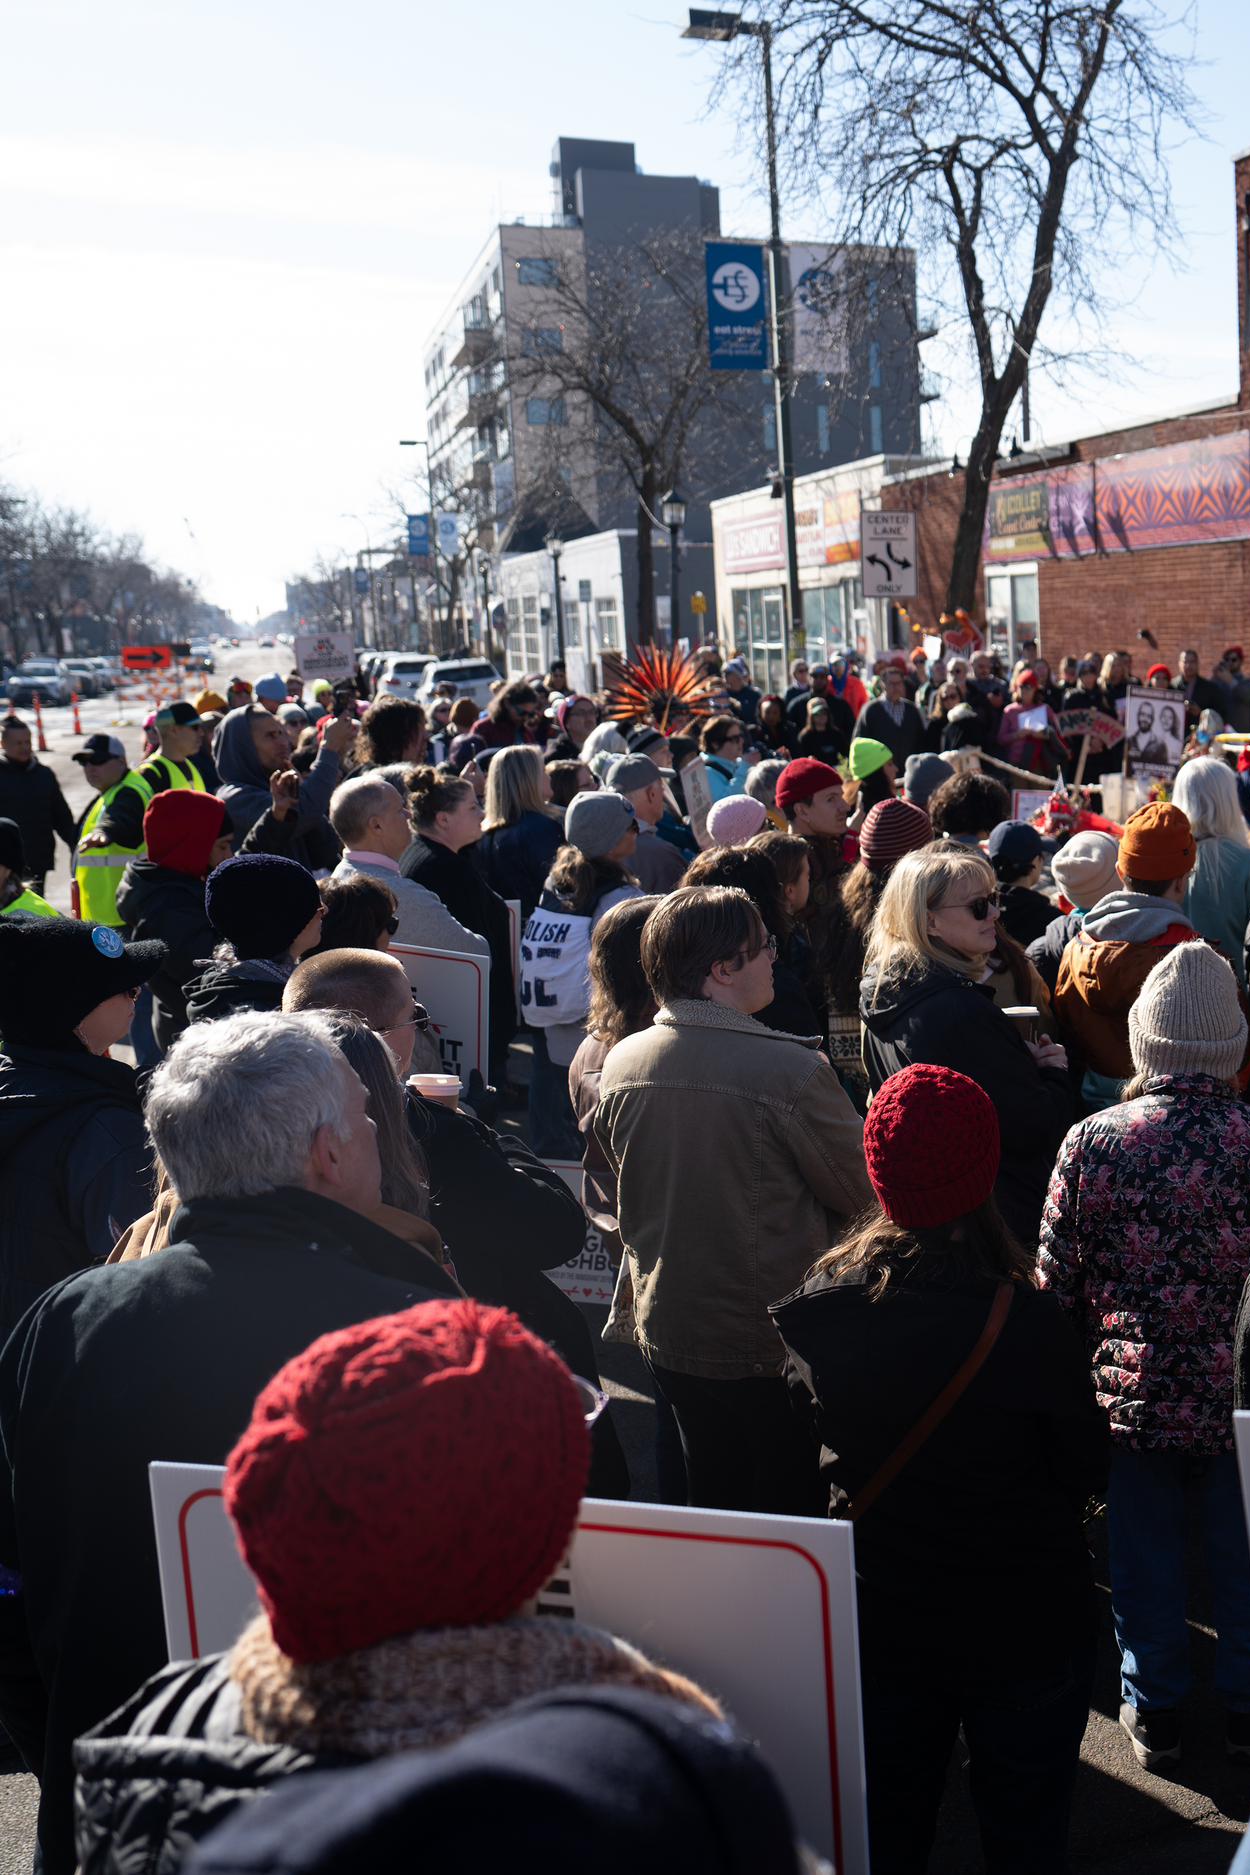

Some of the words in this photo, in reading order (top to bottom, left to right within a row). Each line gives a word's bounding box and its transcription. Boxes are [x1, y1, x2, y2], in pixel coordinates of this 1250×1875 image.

[868, 515, 909, 524] CENTER
[874, 526, 904, 535] LANE
[876, 584, 902, 593] ONLY
[525, 919, 571, 943] OLISH
